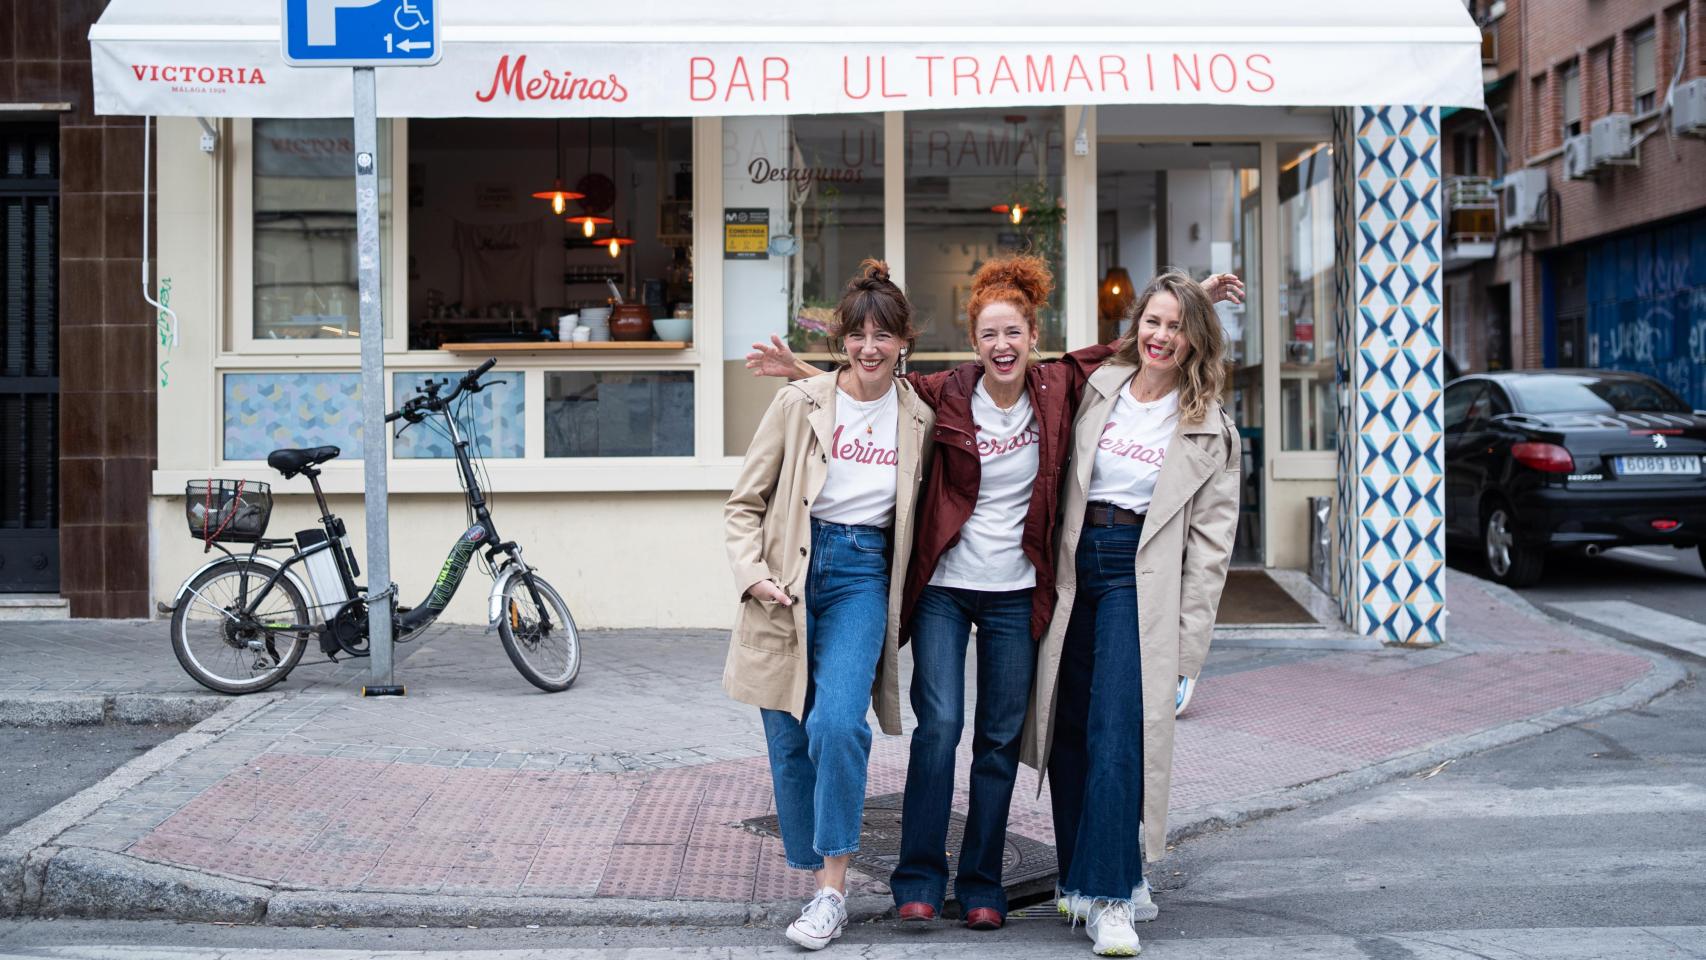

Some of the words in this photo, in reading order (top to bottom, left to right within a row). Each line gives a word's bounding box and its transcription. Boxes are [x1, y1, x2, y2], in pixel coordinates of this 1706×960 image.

[383, 33, 393, 53] 1
[132, 65, 266, 84] VICTORIA
[475, 54, 629, 102] Merinas
[689, 56, 789, 101] BAR
[844, 52, 1274, 99] ULTRAMARINOS
[748, 157, 864, 192] Desayunos
[831, 424, 898, 466] erina
[1098, 421, 1165, 467] erinas
[1626, 456, 1665, 475] 6089
[1669, 456, 1696, 474] BVY
[437, 558, 454, 586] VOLTA
